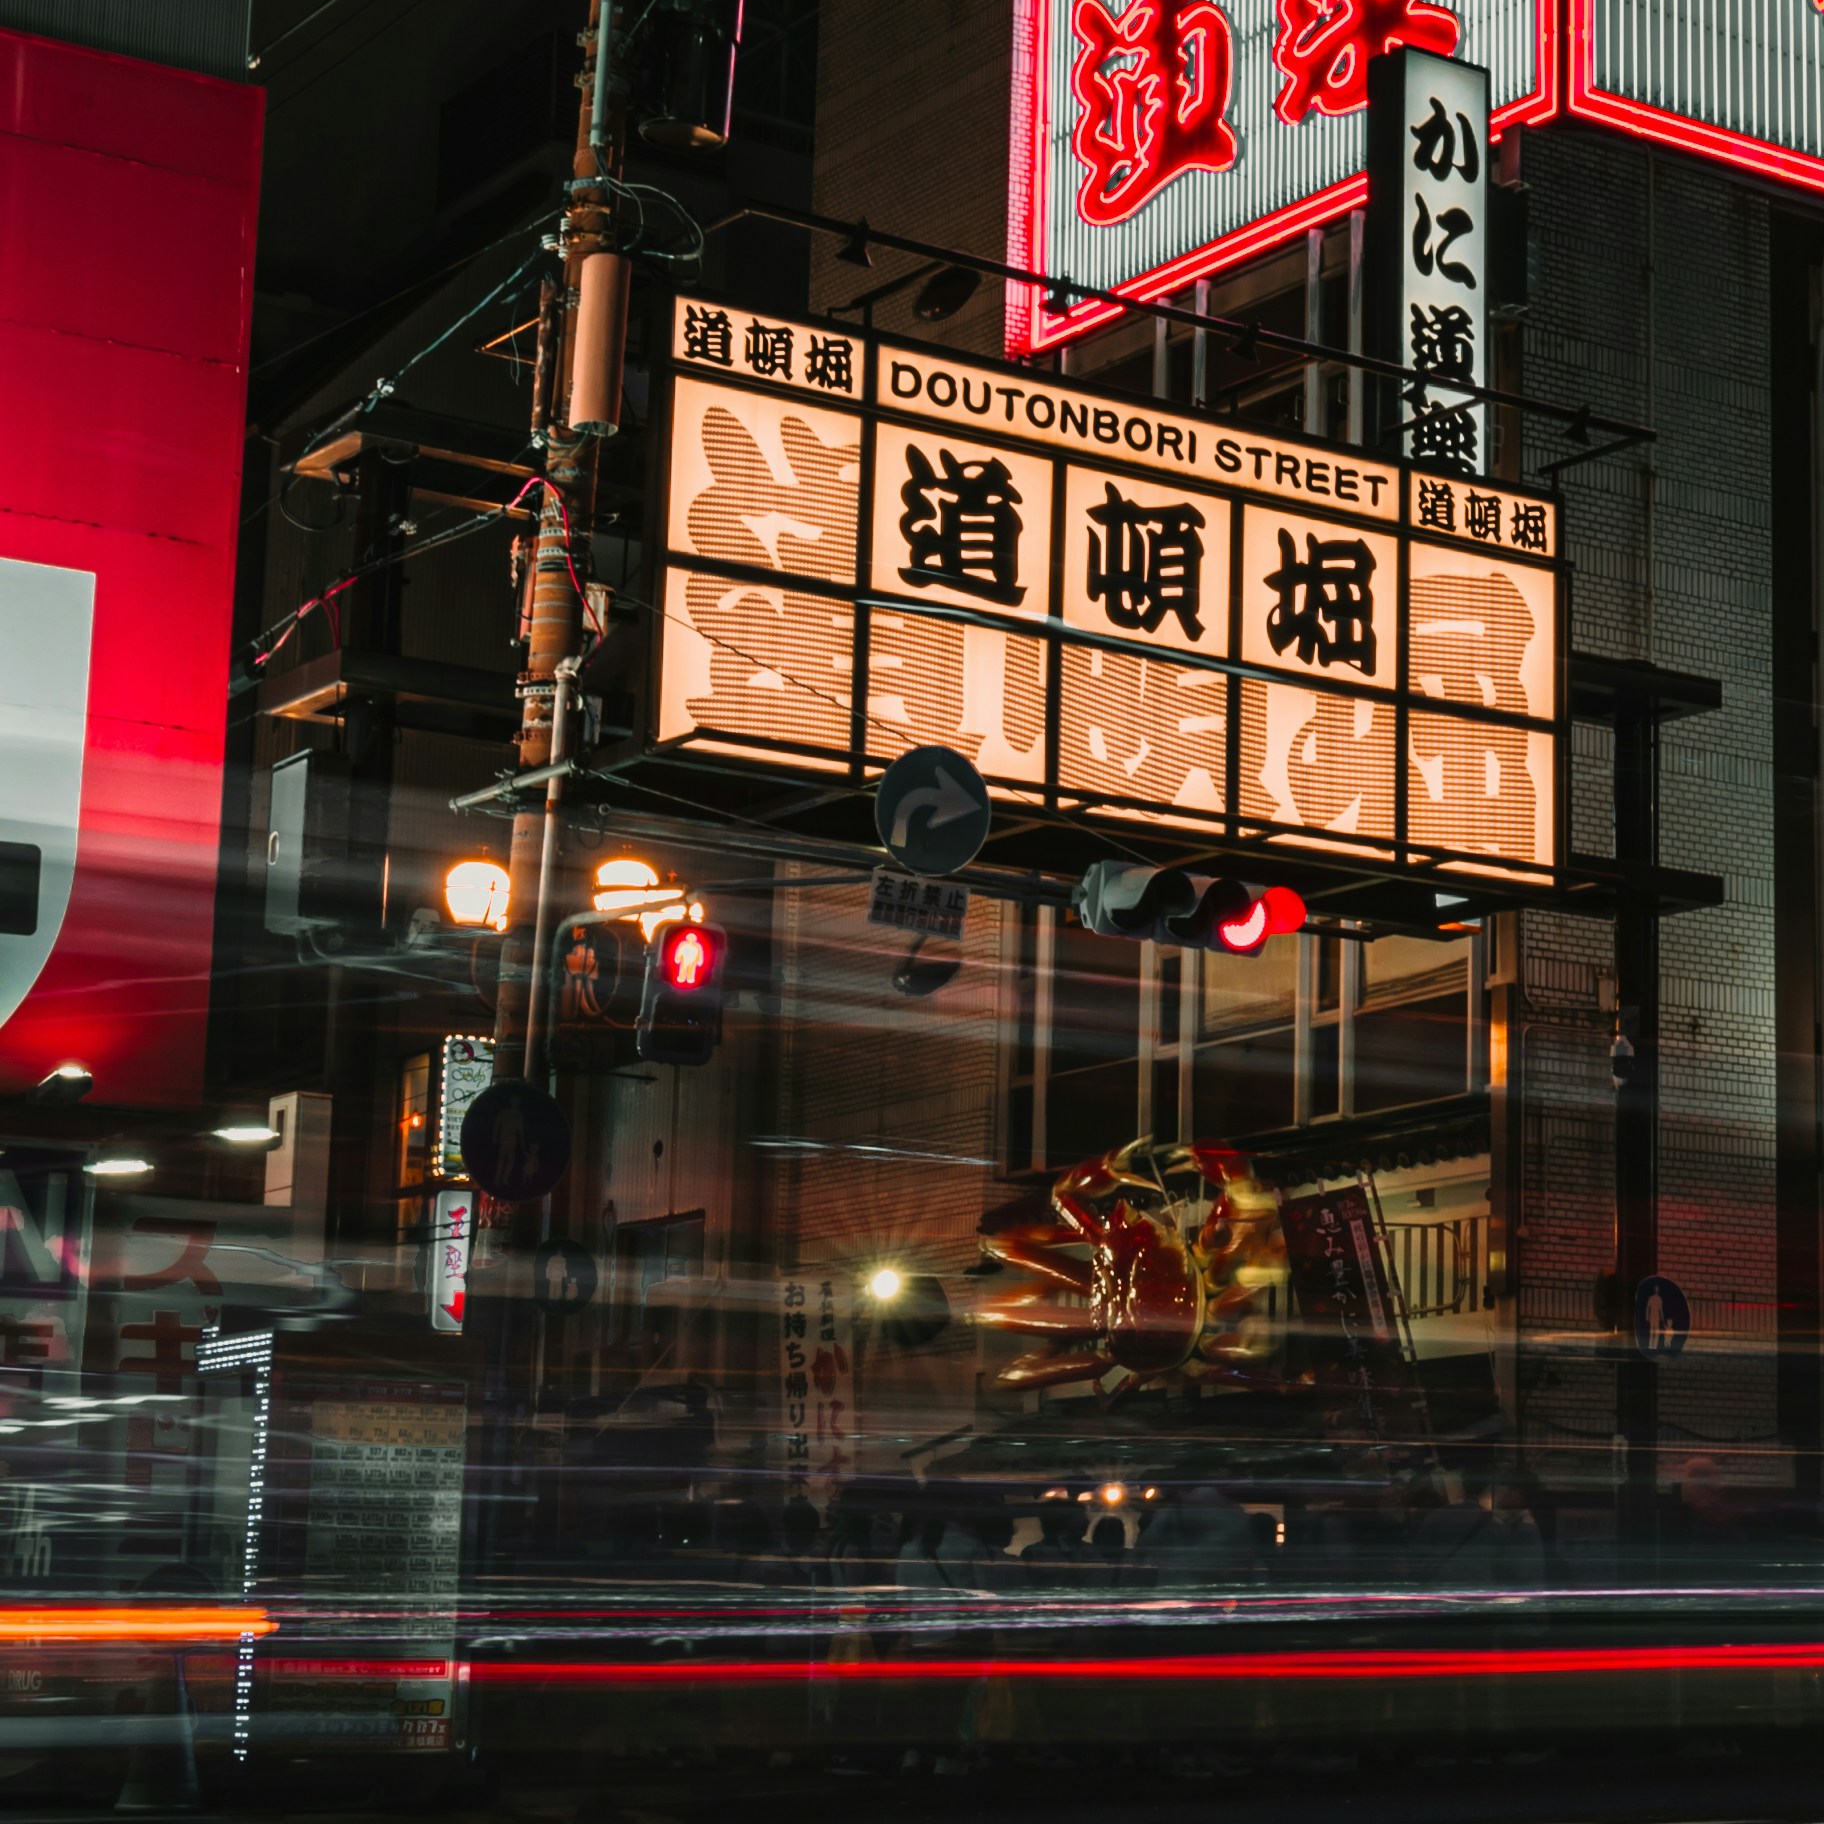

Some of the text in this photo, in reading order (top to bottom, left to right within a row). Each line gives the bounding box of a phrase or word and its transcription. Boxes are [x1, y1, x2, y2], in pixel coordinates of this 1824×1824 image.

[683, 304, 854, 394] 道頓堀
[891, 361, 1389, 506] DOUTONBORI STREET
[898, 443, 1378, 676] 道頓堀
[1418, 478, 1548, 554] 道頓堀
[876, 876, 964, 911] 左折禁止
